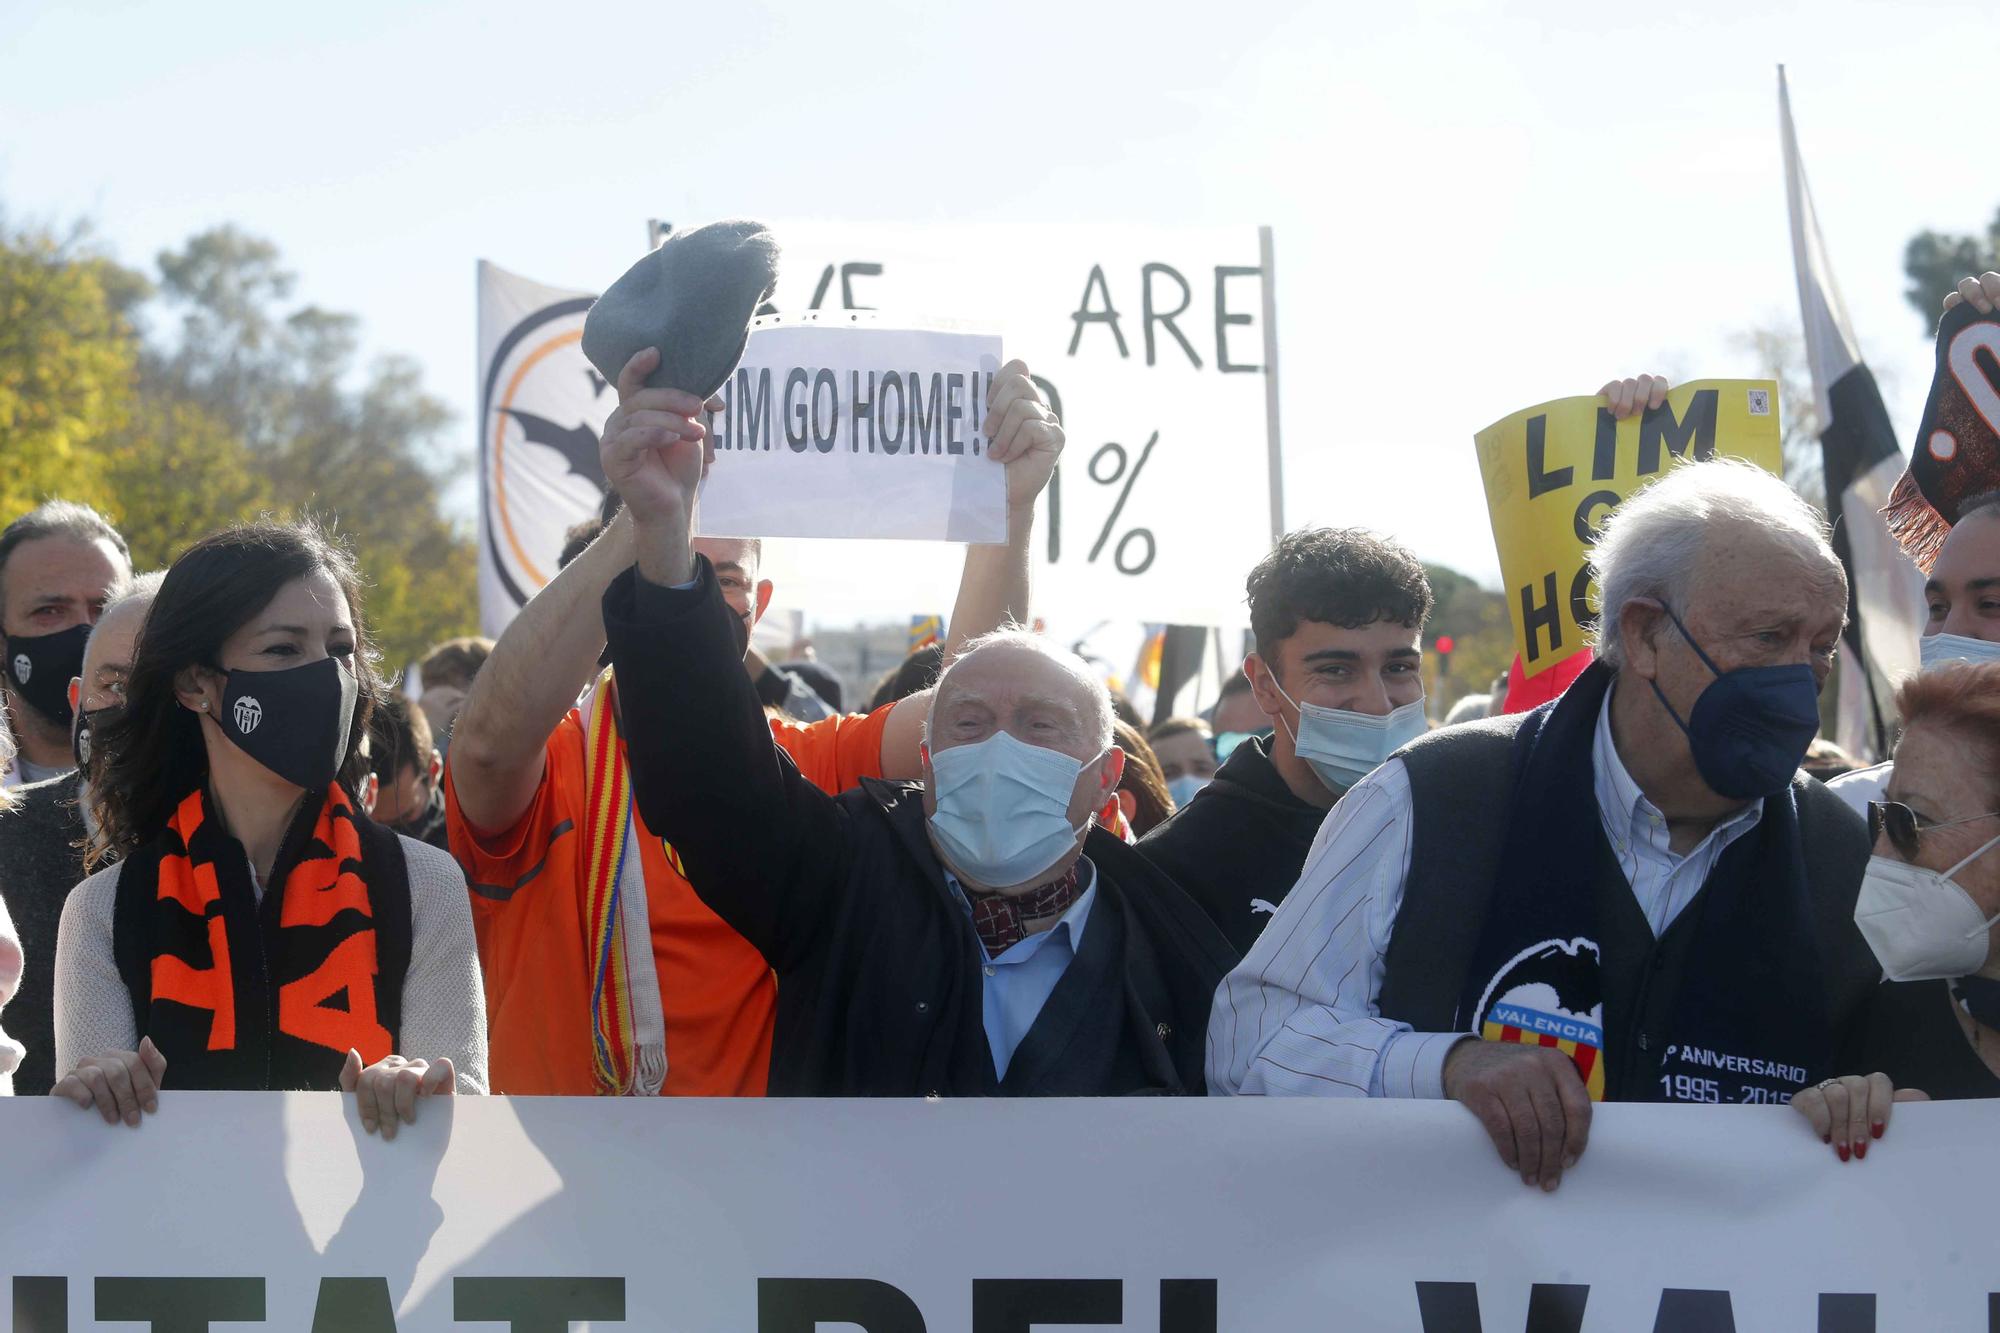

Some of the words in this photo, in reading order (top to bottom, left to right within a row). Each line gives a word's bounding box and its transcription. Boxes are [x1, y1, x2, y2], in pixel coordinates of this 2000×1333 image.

[1066, 263, 1268, 374] ARE
[784, 367, 839, 454] GO
[1526, 389, 1719, 500] LIM
[1495, 1007, 1600, 1043] VALENCIA
[1660, 1044, 1678, 1067] º
[1680, 1044, 1807, 1084] ANIVERSARIO
[1660, 1074, 1720, 1104] 1995
